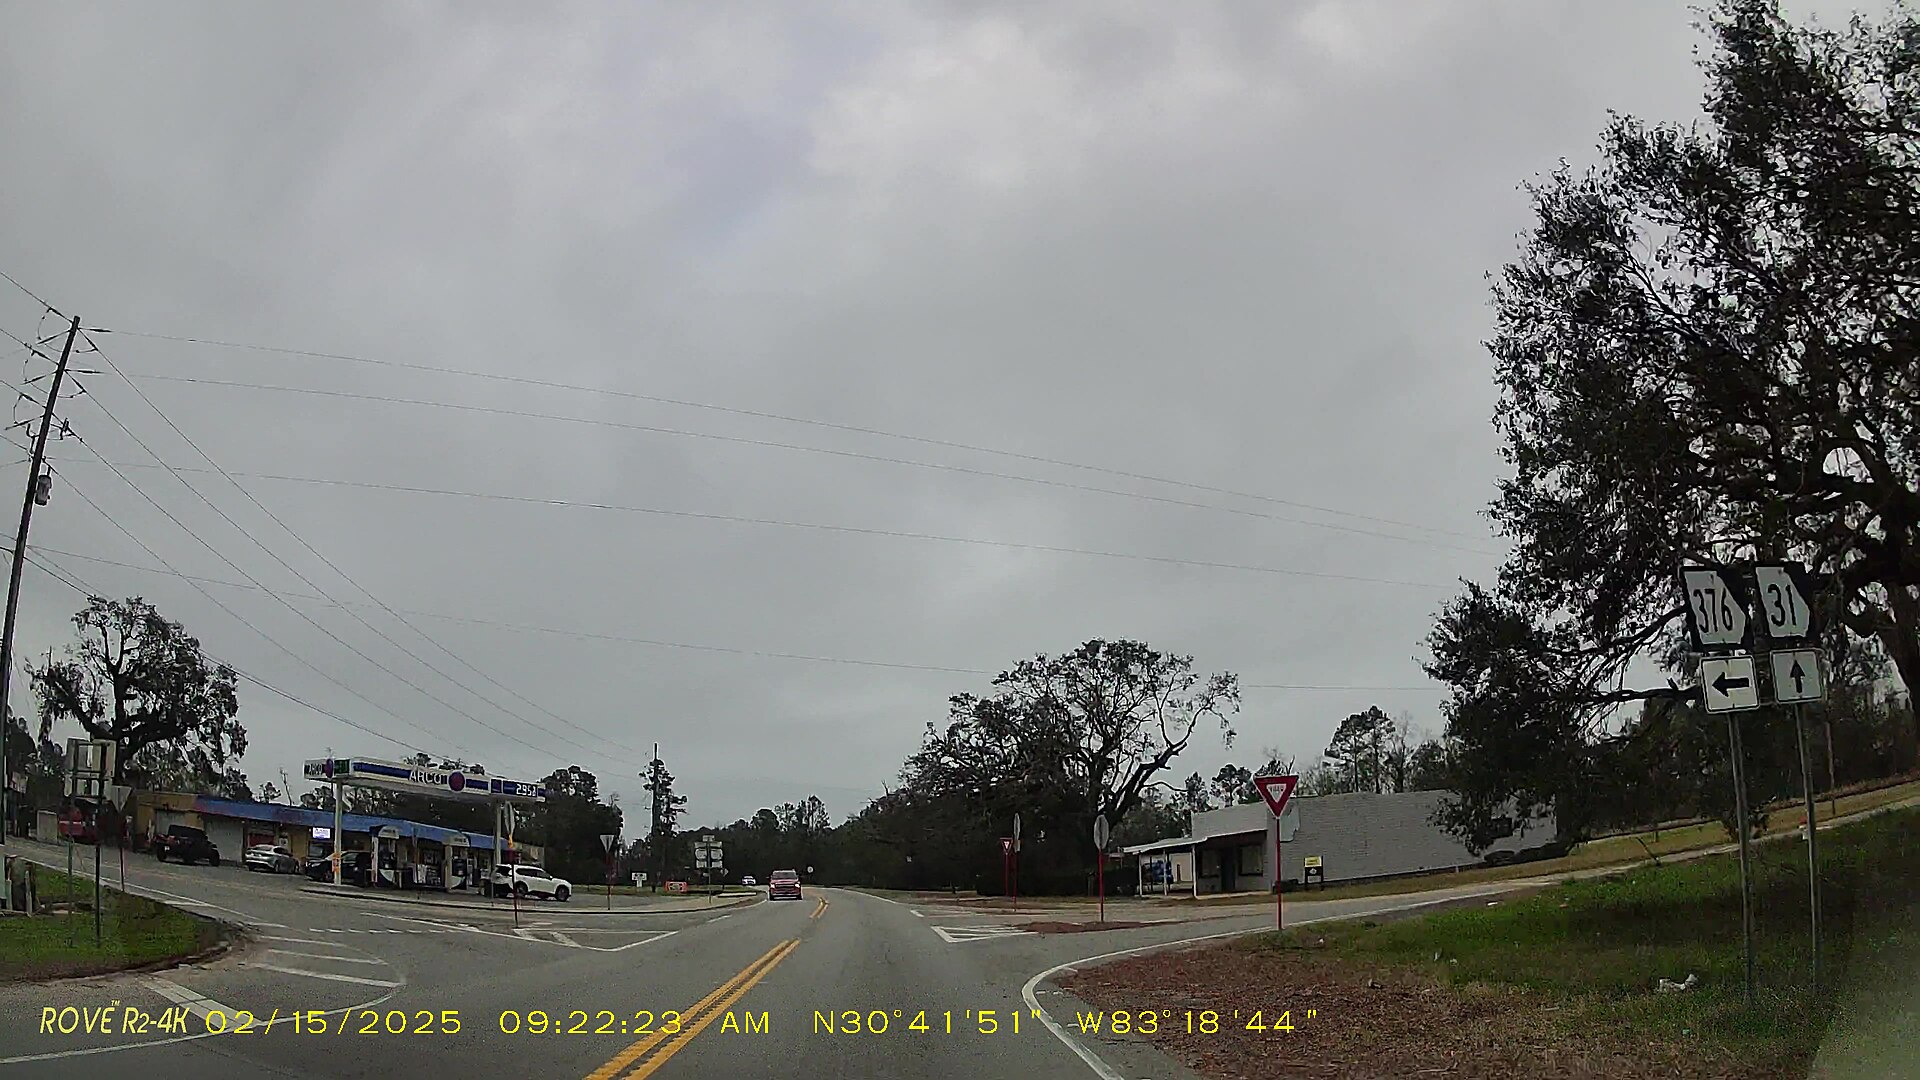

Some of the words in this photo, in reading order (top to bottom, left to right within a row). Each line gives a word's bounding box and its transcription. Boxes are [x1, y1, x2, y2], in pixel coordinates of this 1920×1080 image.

[1692, 588, 1732, 634] 376
[1767, 583, 1797, 627] 31
[409, 767, 442, 785] ARCO
